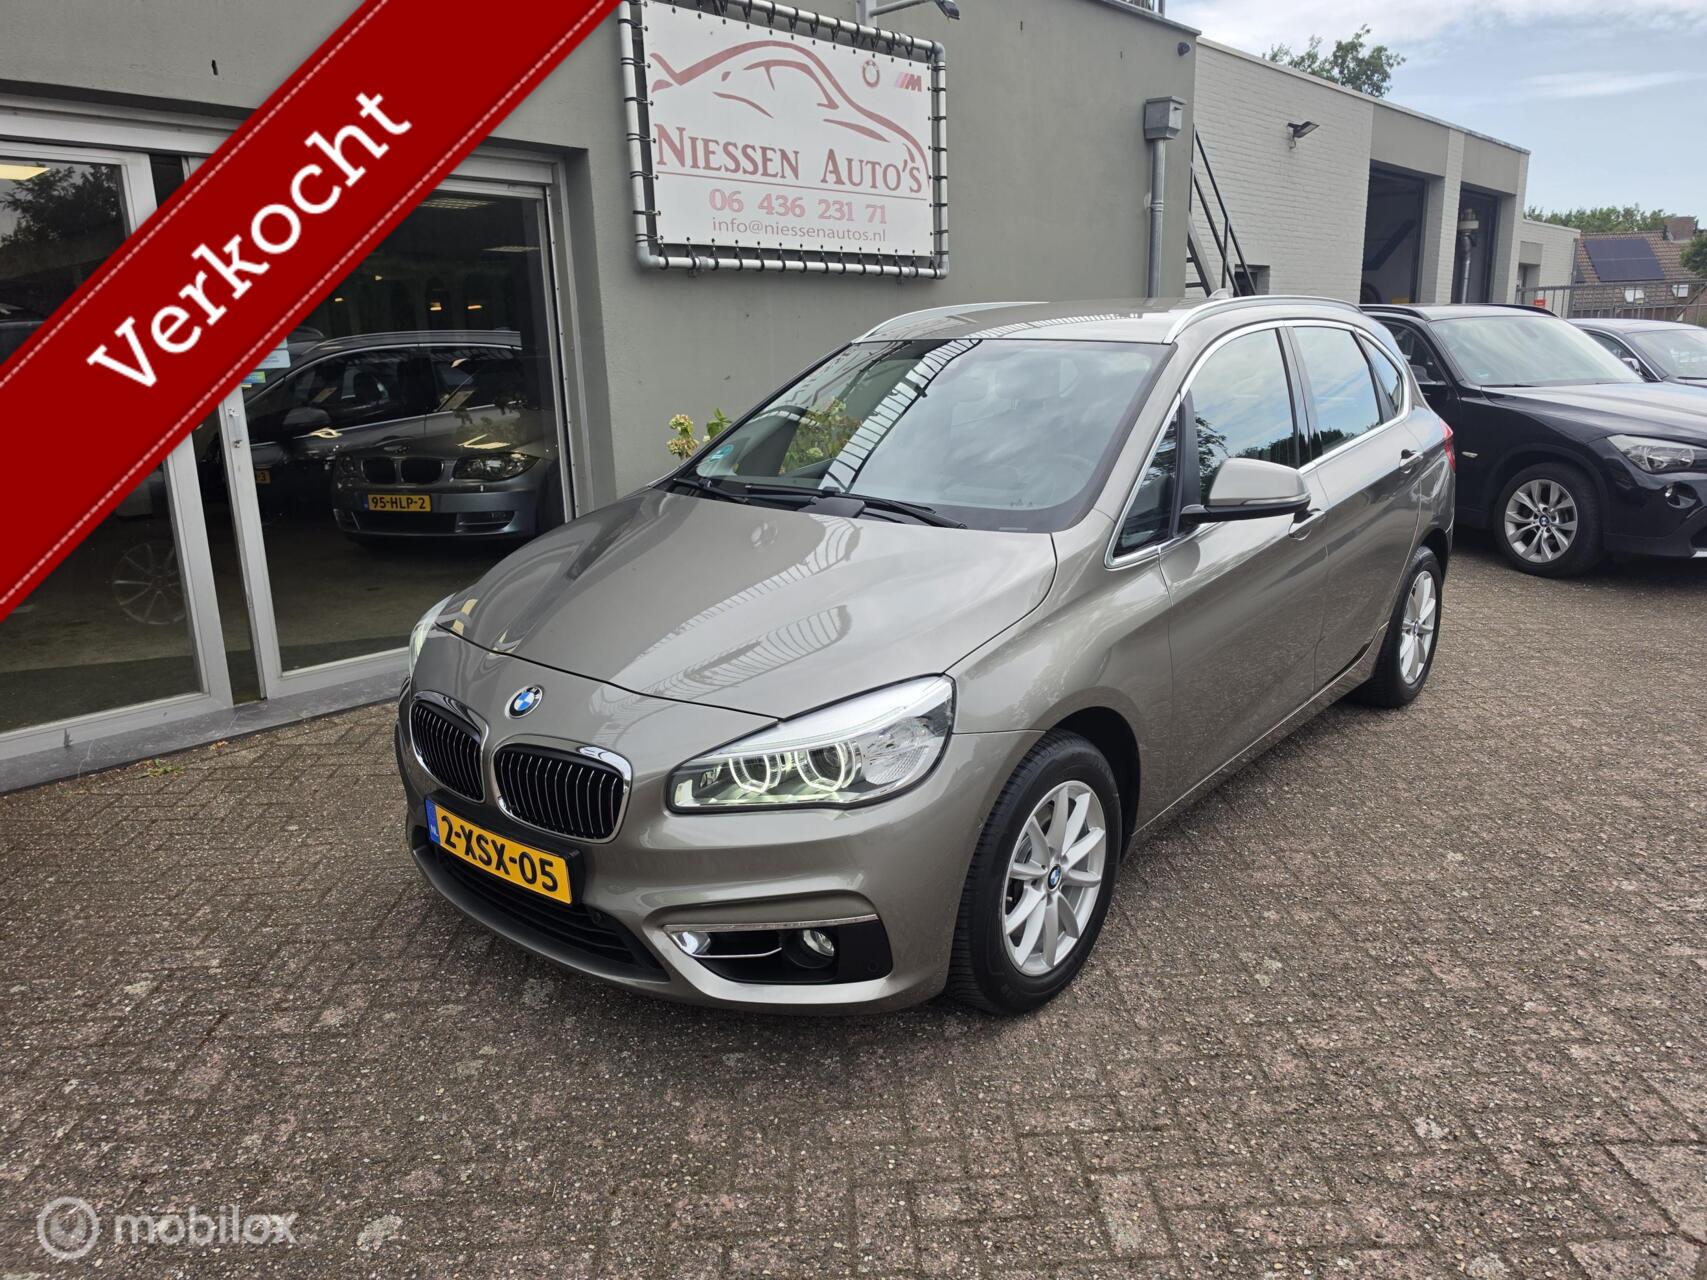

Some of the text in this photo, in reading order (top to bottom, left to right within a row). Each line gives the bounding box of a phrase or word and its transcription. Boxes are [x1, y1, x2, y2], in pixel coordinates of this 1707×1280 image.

[654, 123, 800, 181] NIESSEN
[709, 188, 888, 225] 06 436 231 71
[712, 217, 887, 242] info@niessenautos.nl
[371, 496, 426, 510] 95-HLP-2
[441, 815, 559, 892] 2-XSX-05
